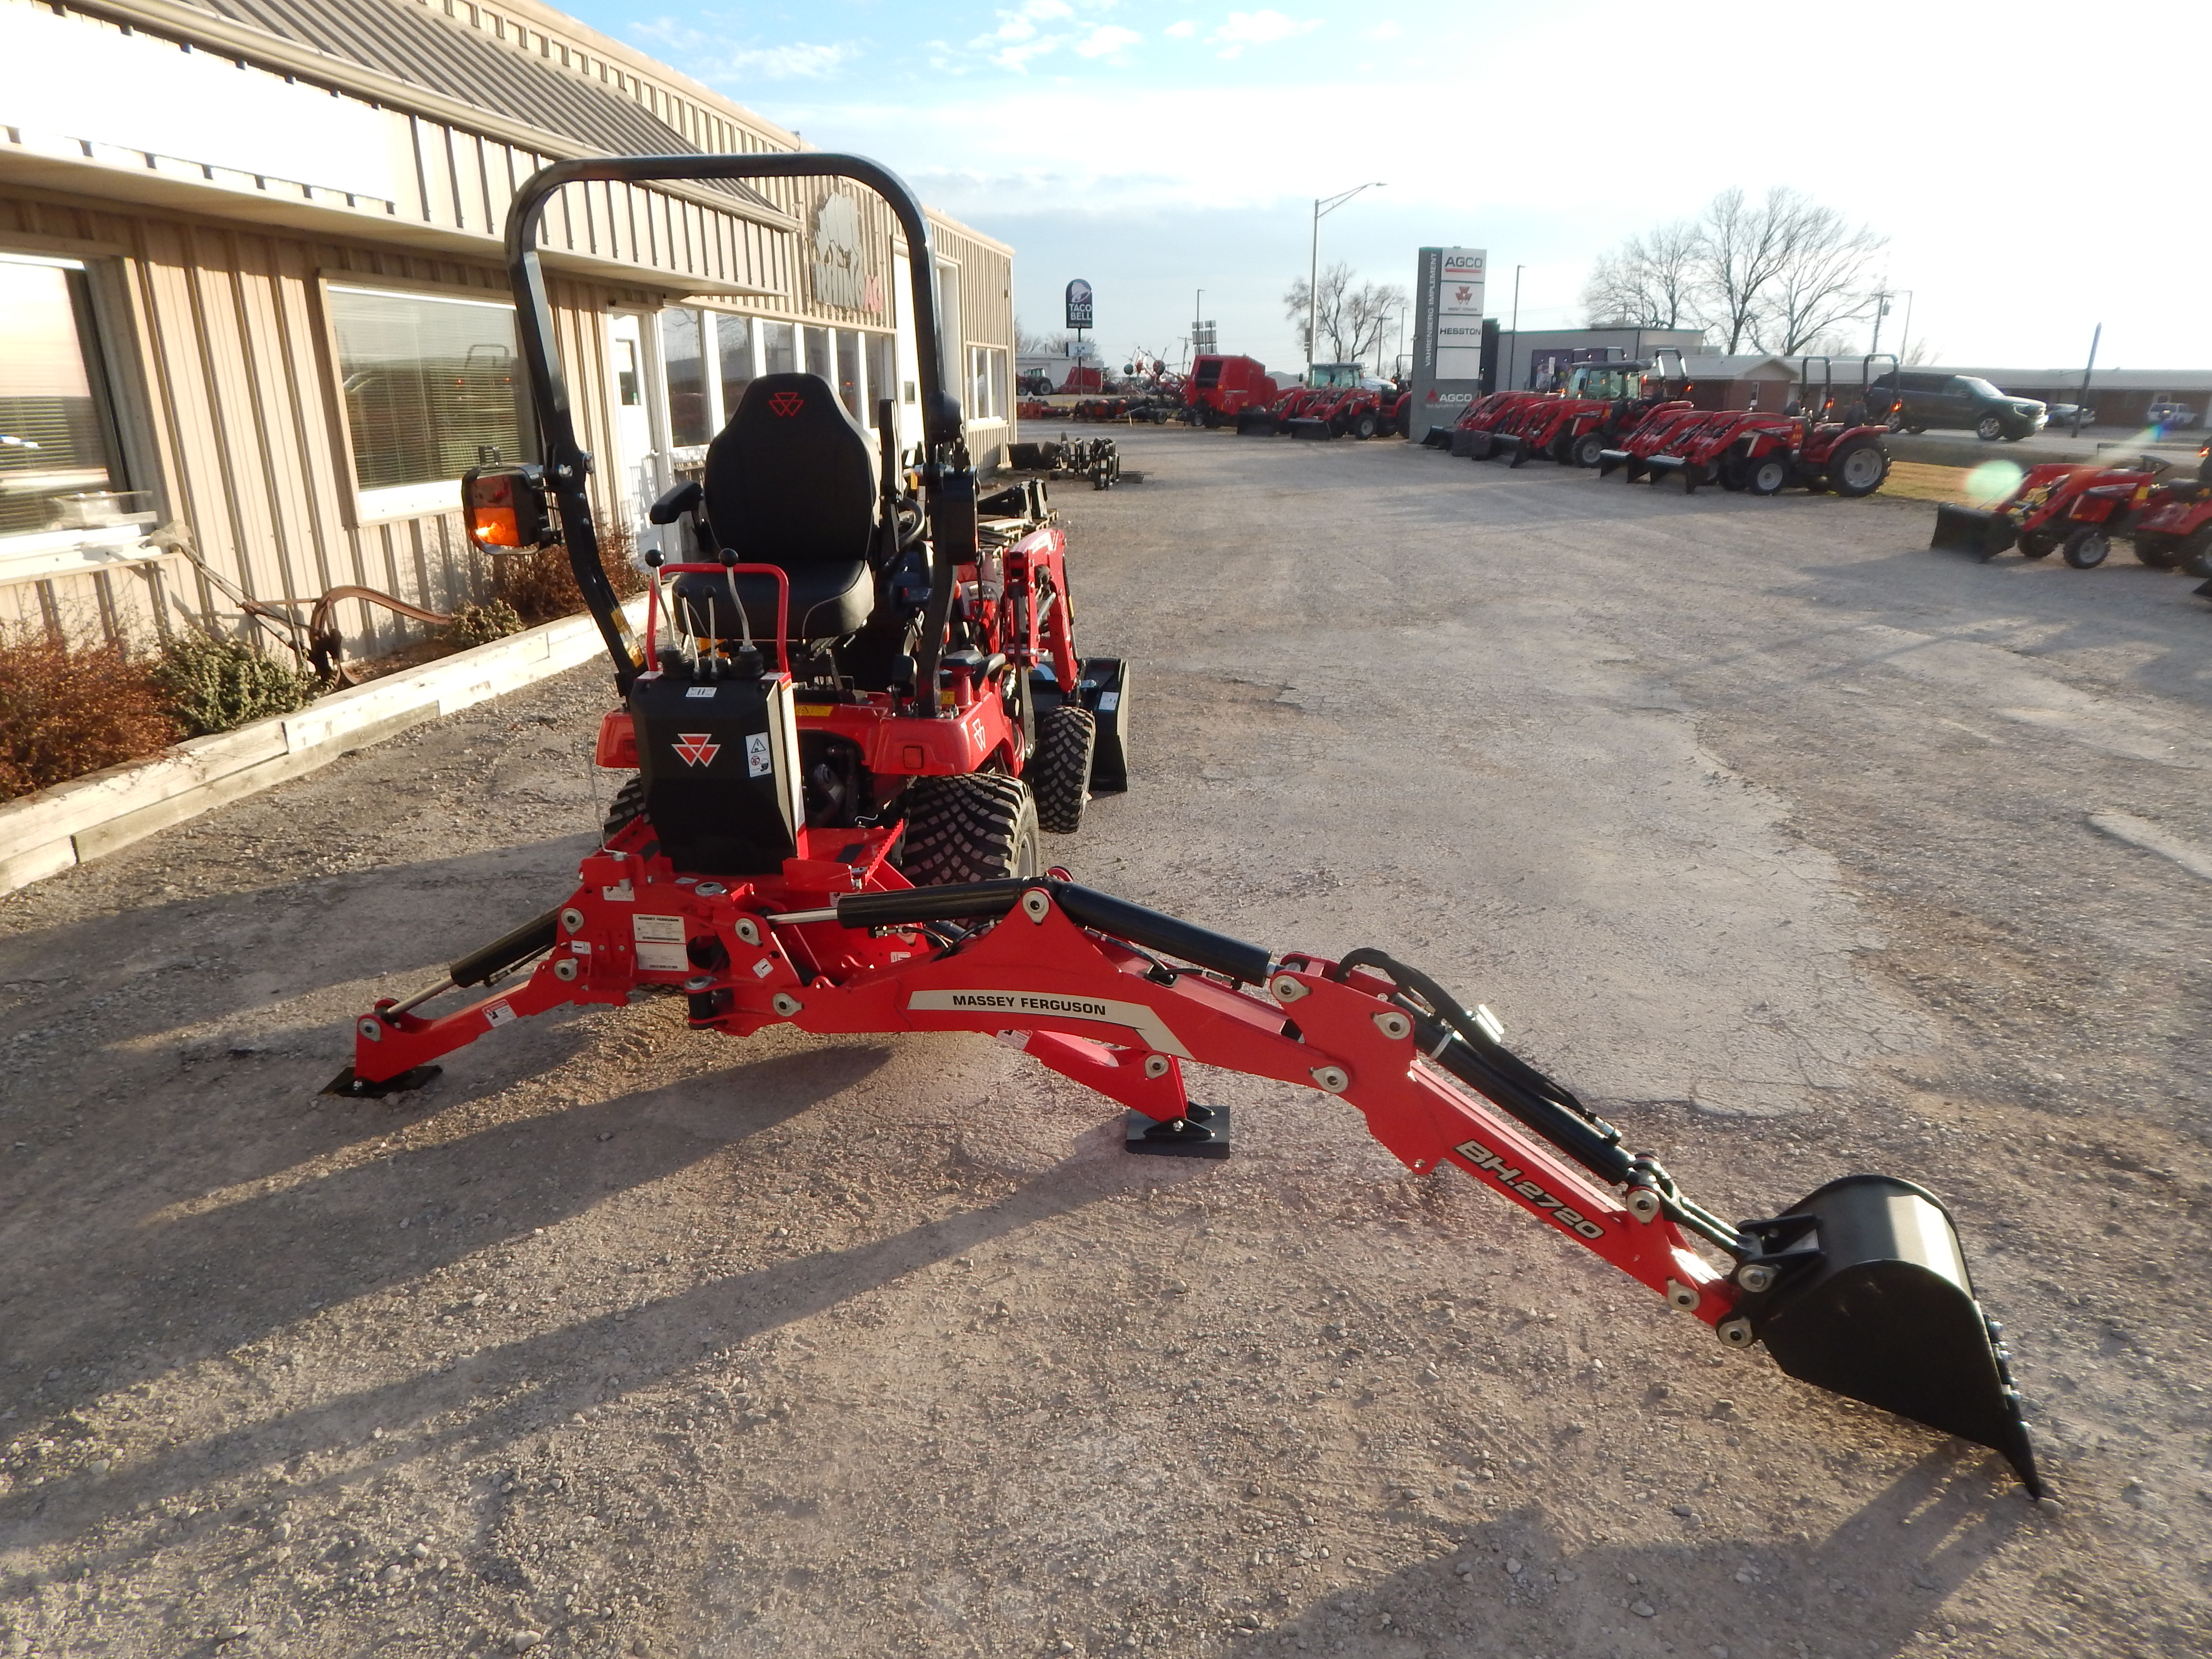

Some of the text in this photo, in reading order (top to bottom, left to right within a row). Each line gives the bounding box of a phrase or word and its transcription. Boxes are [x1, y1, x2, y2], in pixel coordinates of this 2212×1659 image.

[1444, 256, 1483, 268] AGCO
[815, 261, 884, 313] RHINO AG
[1069, 303, 1092, 312] TACO
[1425, 252, 1437, 367] VAHRENBERG IMPLEMENT
[1070, 312, 1092, 321] BELL
[1439, 393, 1473, 402] AGCO
[953, 995, 1106, 1015] MASSEY FERGUSON
[1455, 1140, 1605, 1239] BH.2720
